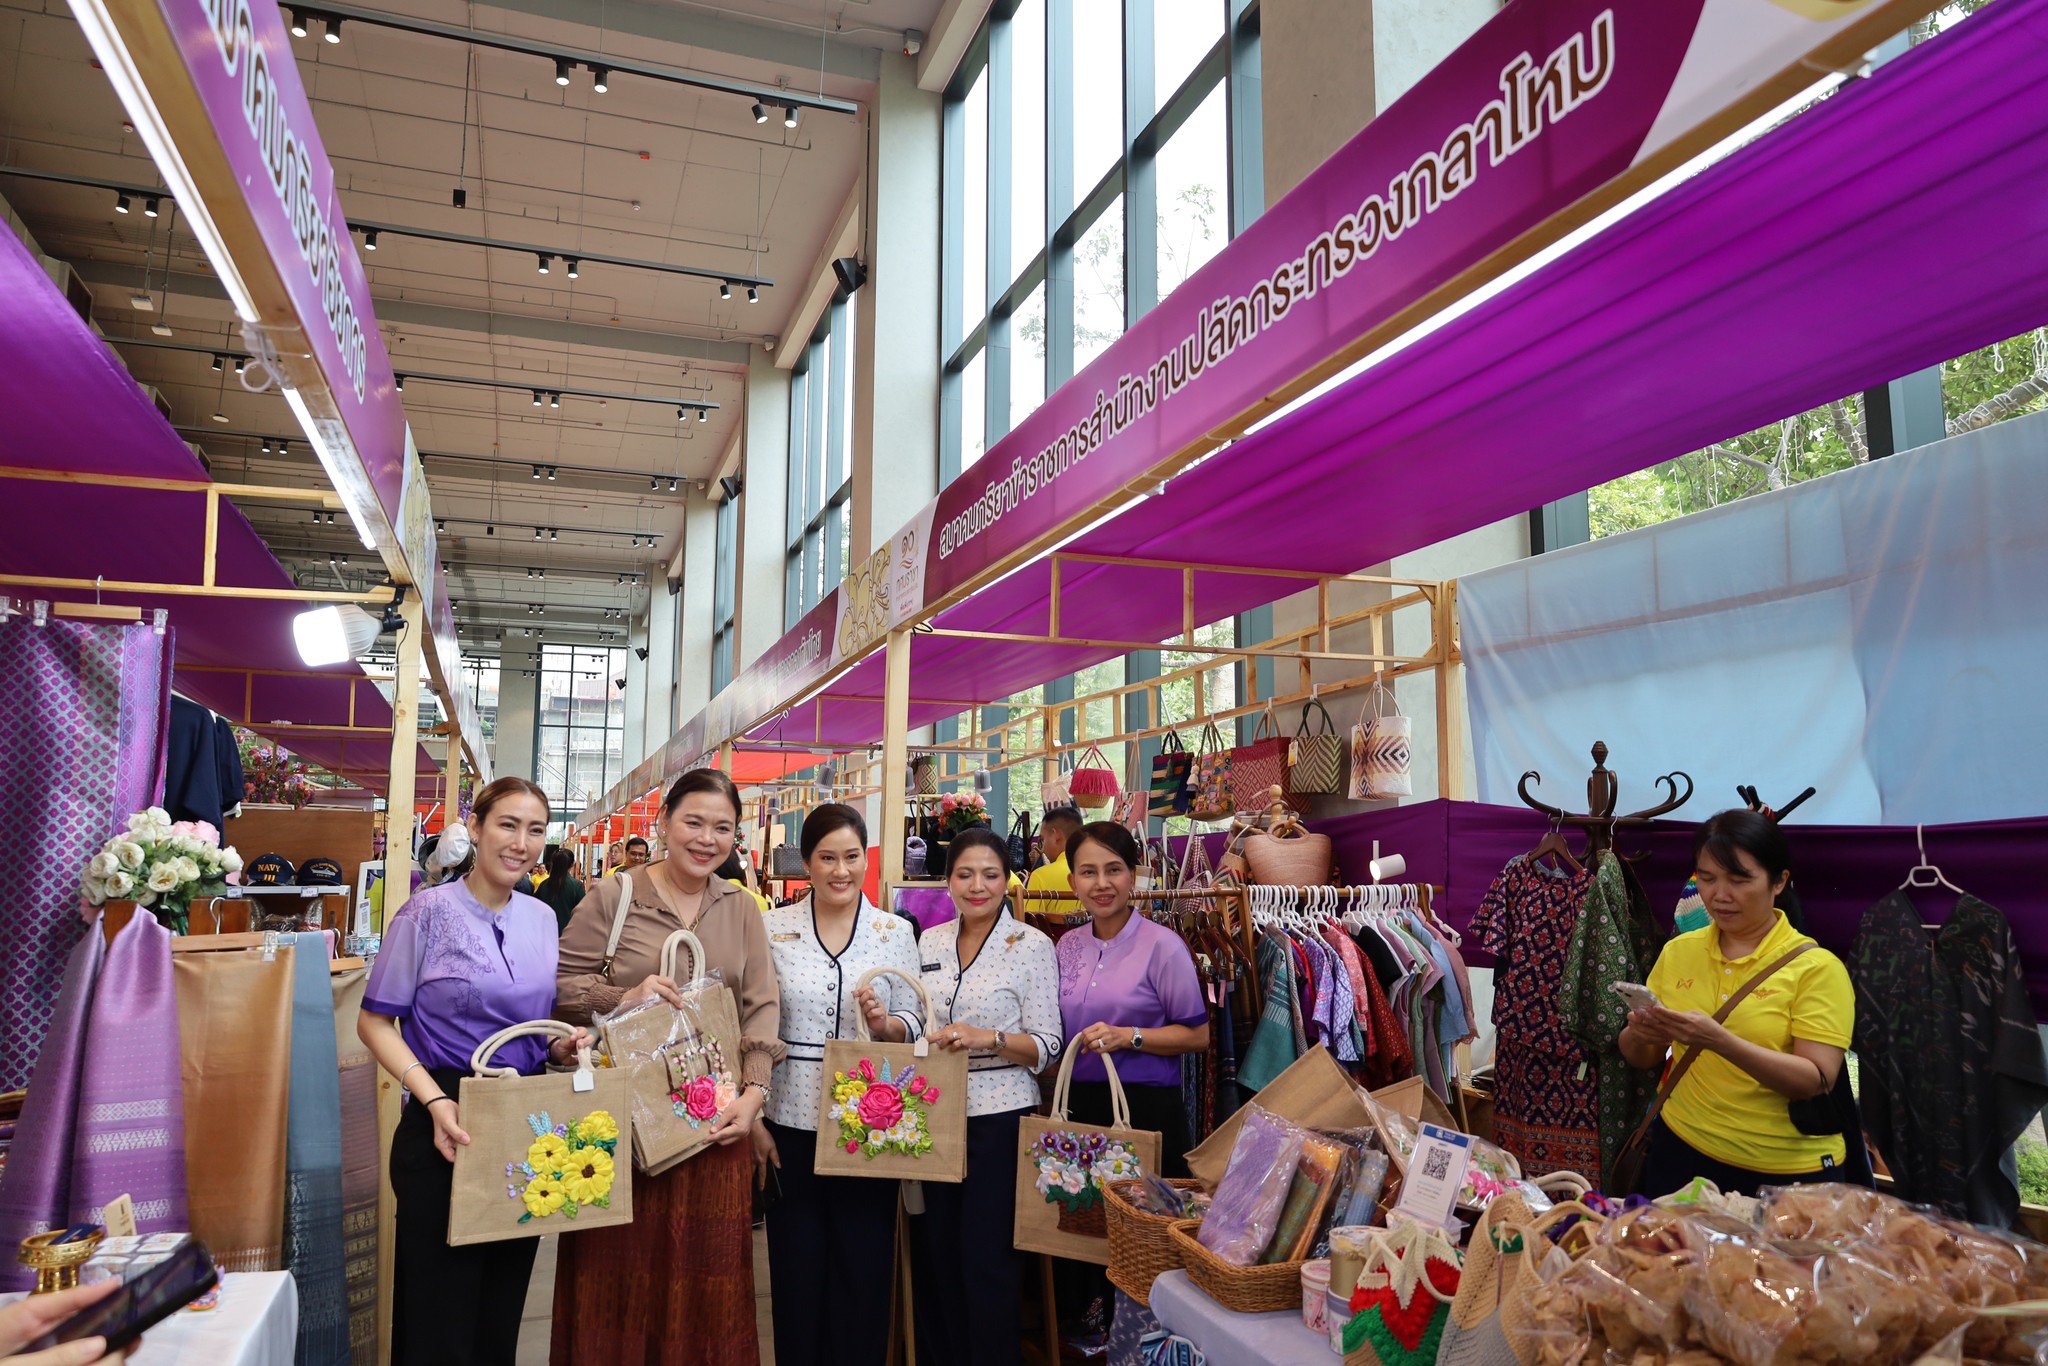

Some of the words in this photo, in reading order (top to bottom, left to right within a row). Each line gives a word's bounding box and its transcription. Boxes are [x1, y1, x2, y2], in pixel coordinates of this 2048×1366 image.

[940, 9, 1616, 560] สมาคมภริยาข้าราชการสำนักงานปลัดกระทรวงกลาโหม
[257, 864, 281, 872] NAVY
